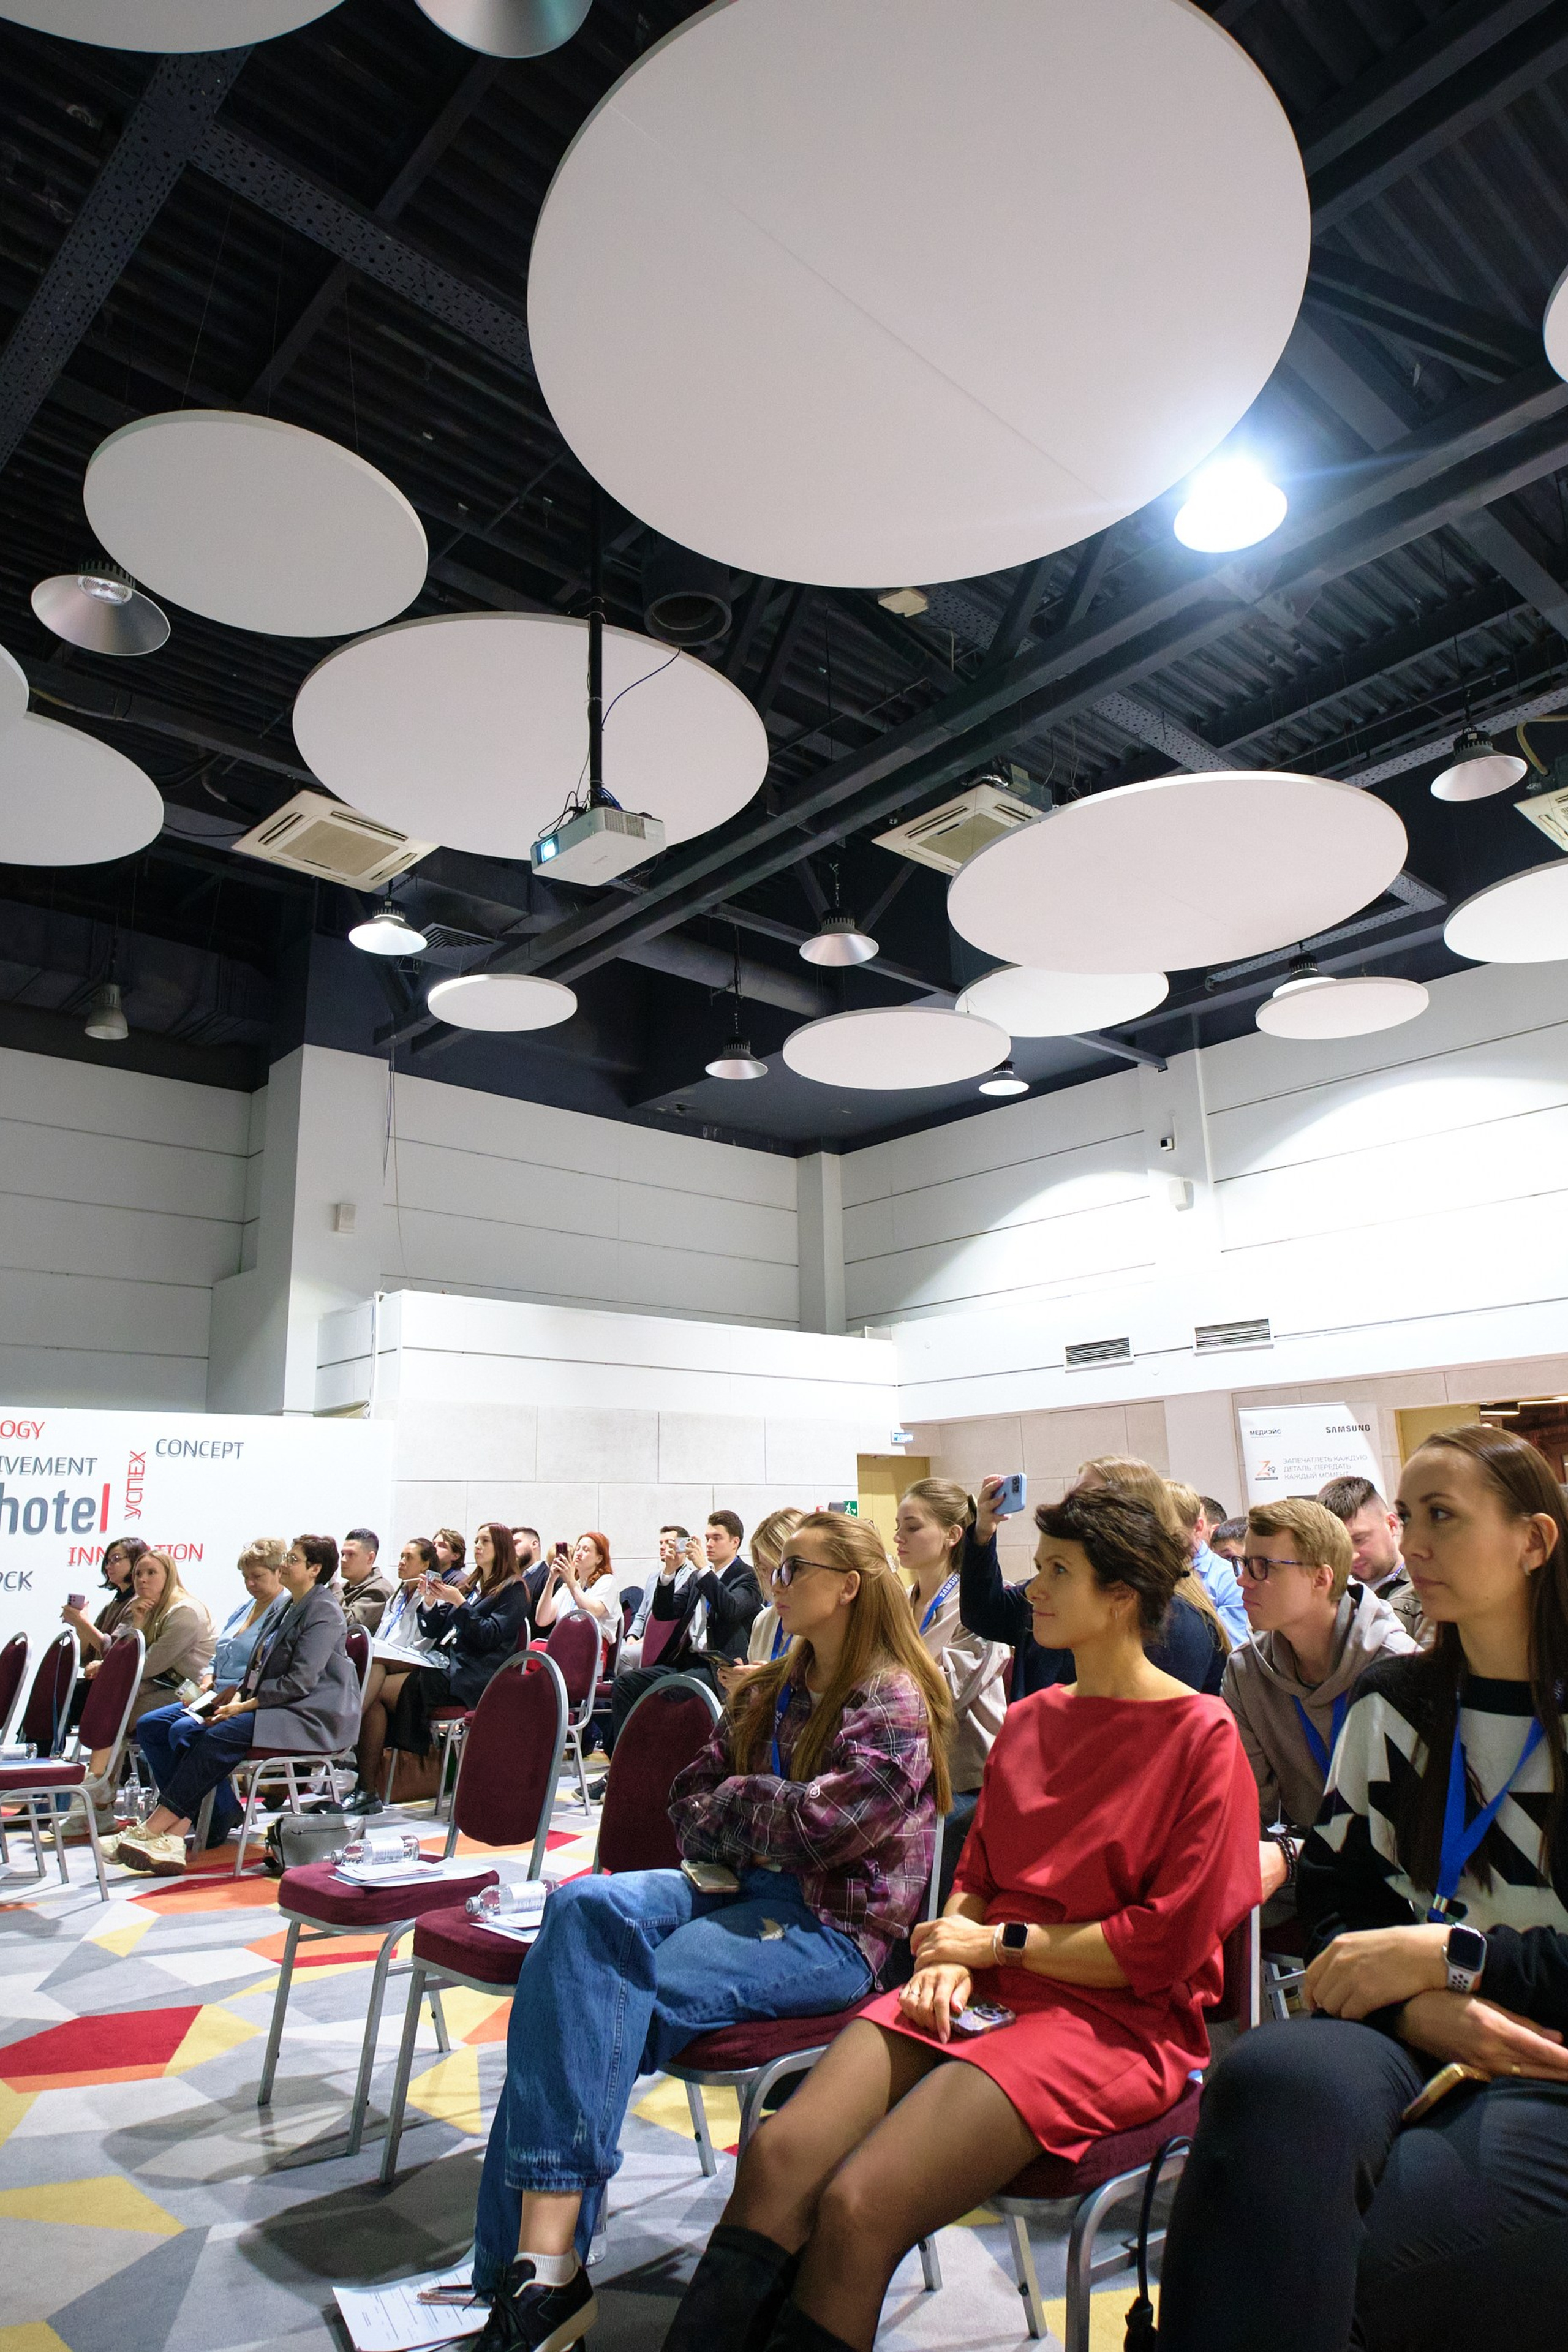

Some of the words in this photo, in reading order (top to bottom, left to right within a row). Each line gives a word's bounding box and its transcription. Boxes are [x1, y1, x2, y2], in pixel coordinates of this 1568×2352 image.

[0, 1420, 45, 1439] OGY
[1326, 1424, 1371, 1434] SAMSUNG
[156, 1439, 244, 1459] CONCEPT
[1333, 1454, 1368, 1463] КАЖДУЮ
[124, 1450, 146, 1520] УСПЕХ
[0, 1482, 110, 1535] hotel
[940, 1574, 960, 1598] SAMSU
